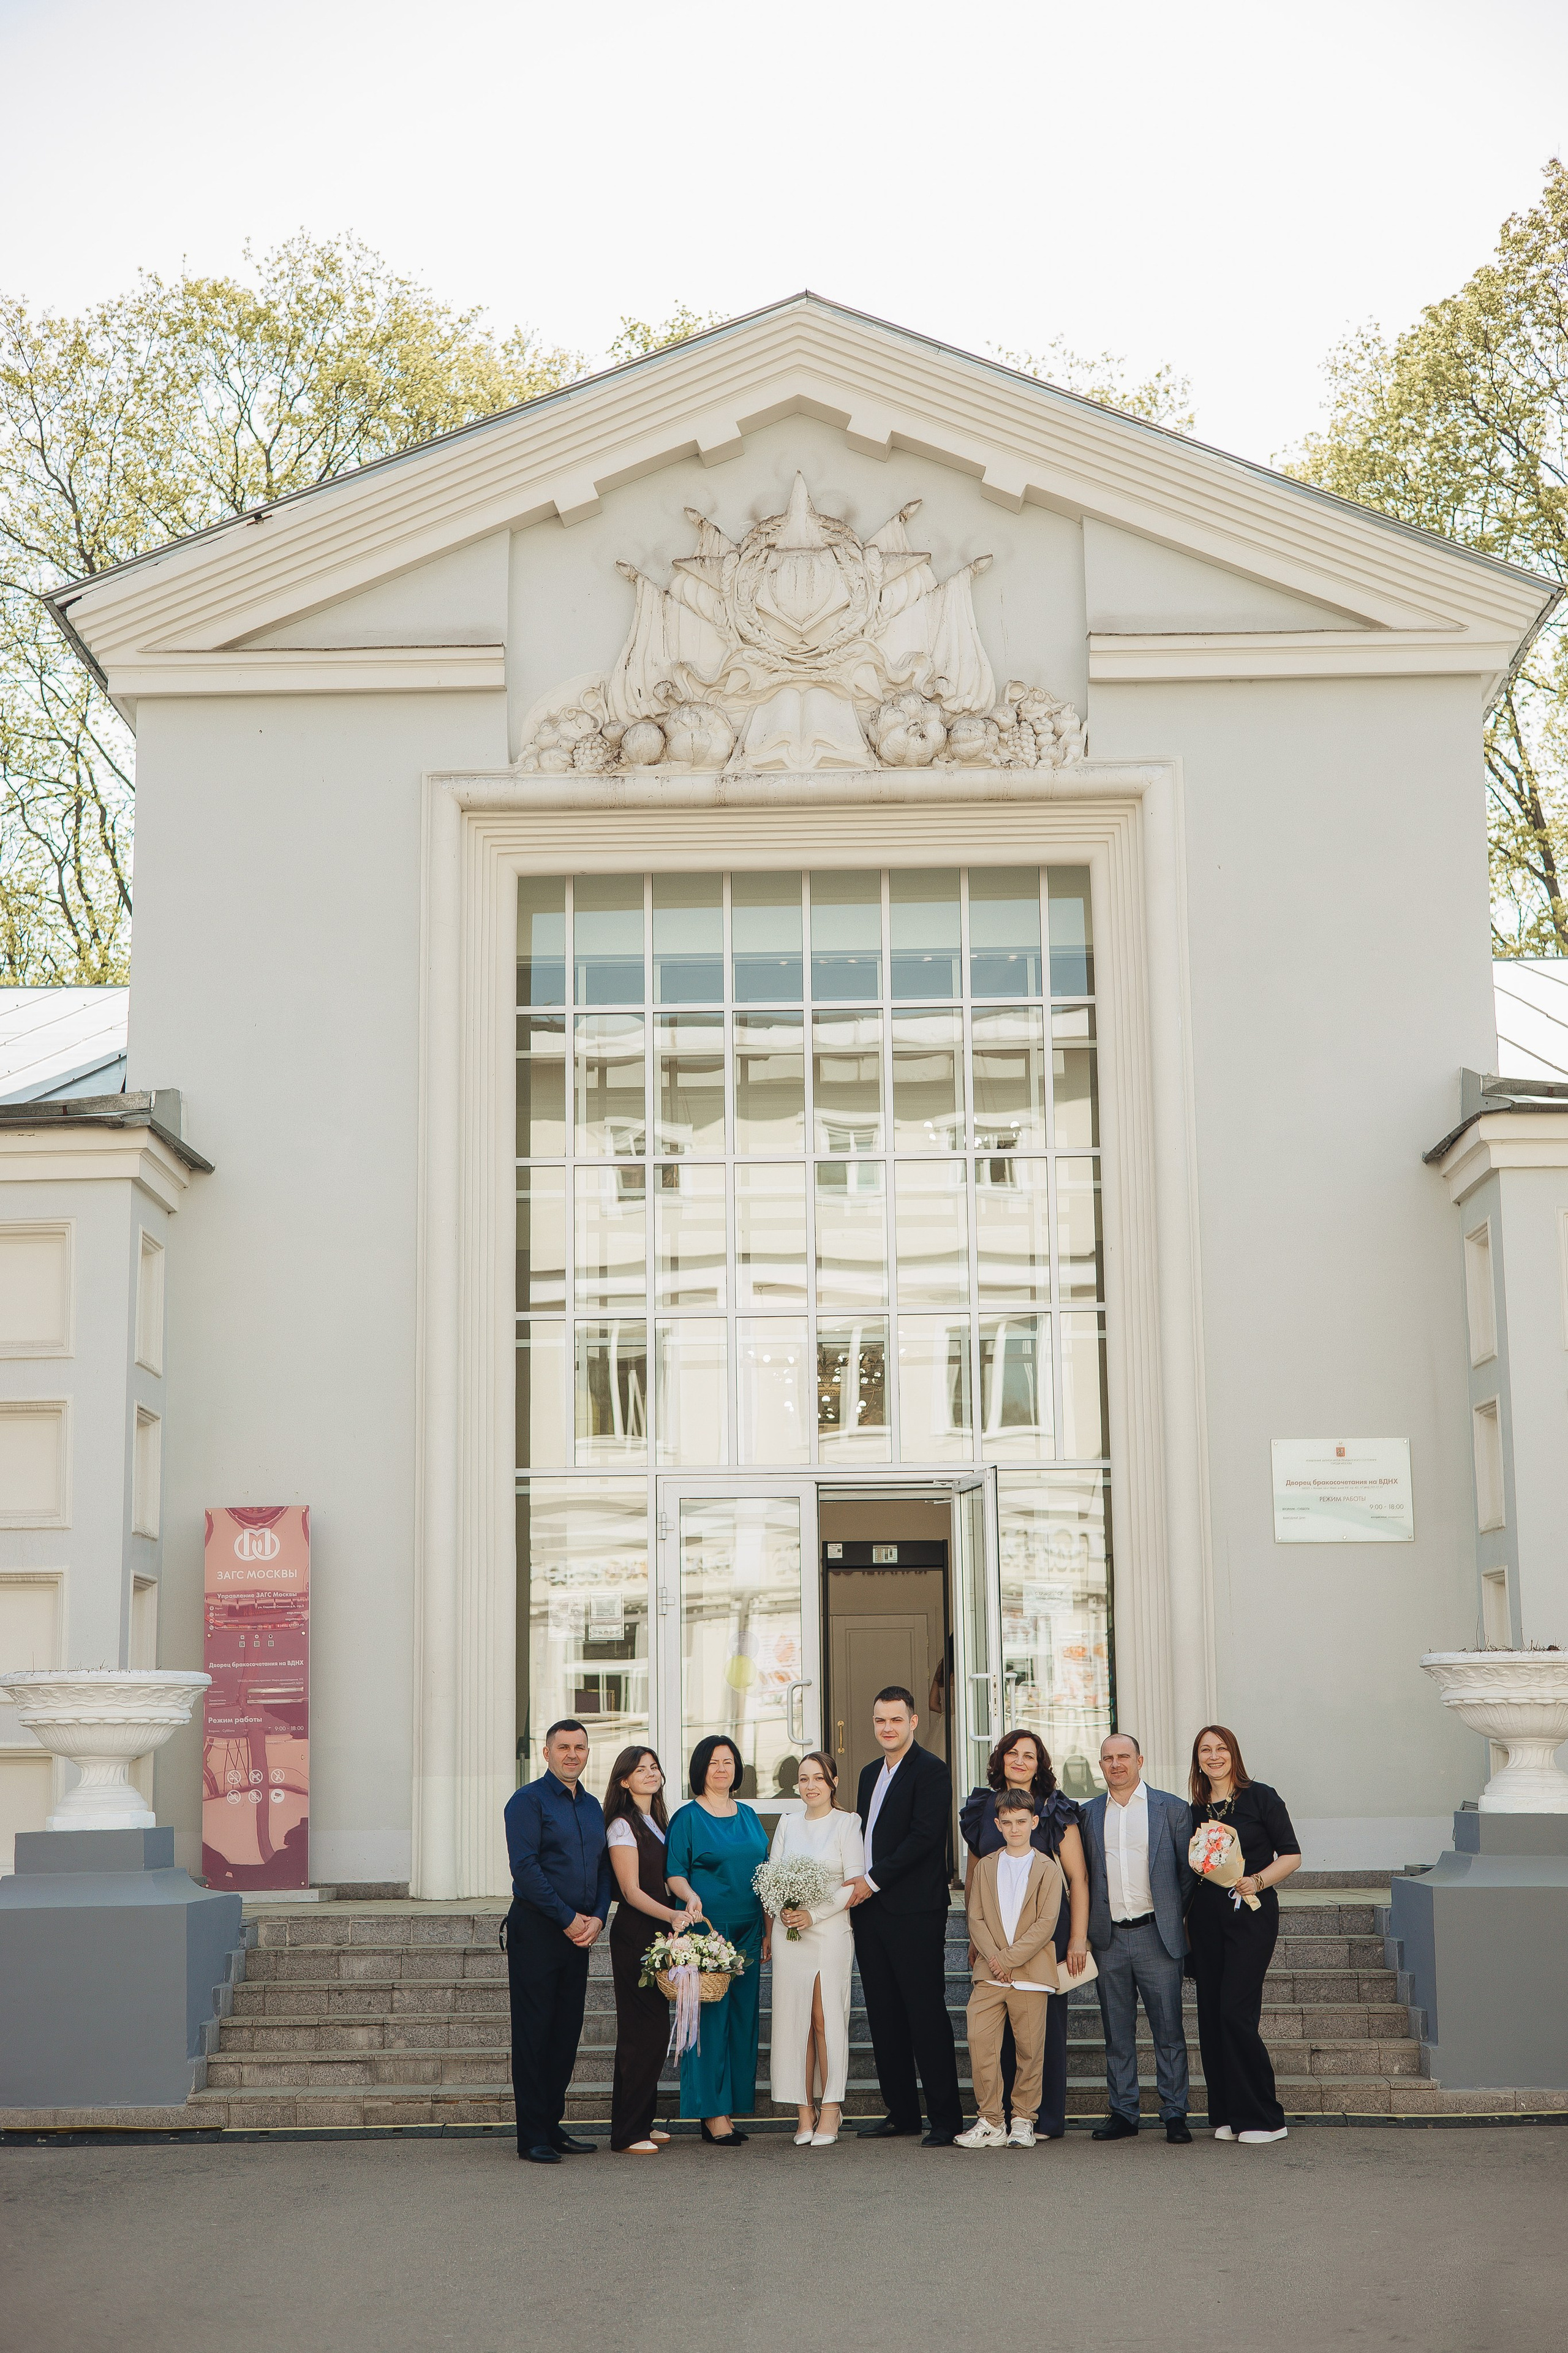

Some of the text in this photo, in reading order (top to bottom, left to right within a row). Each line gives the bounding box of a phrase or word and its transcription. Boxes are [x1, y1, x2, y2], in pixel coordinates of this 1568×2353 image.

[217, 1569, 297, 1580] ЗАГС МОСКВЫ
[235, 1716, 262, 1724] работы
